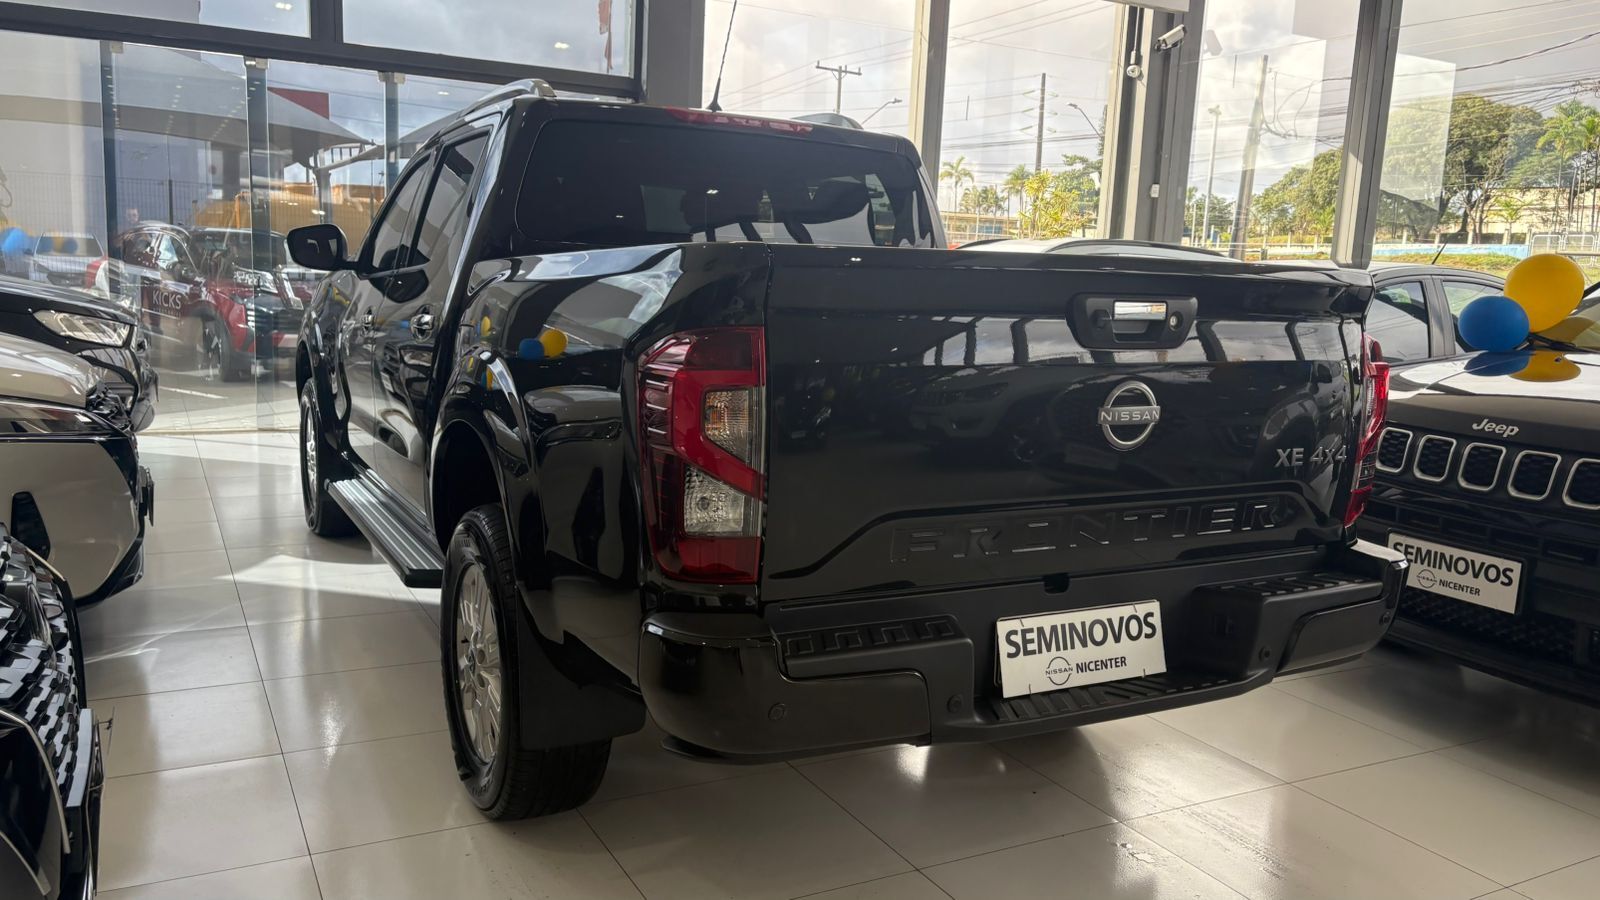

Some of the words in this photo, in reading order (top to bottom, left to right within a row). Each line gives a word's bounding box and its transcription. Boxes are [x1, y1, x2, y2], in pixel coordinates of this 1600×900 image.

[152, 290, 182, 310] KICKS
[1100, 410, 1160, 422] NISSAN
[1472, 418, 1520, 438] Jeep
[1274, 447, 1305, 468] XE
[891, 502, 1280, 563] FRONTIER
[1438, 579, 1481, 597] NICENTER
[1005, 612, 1157, 659] SEMINOVOS
[1045, 666, 1074, 676] NISSAN
[1076, 656, 1127, 674] NICENTER
